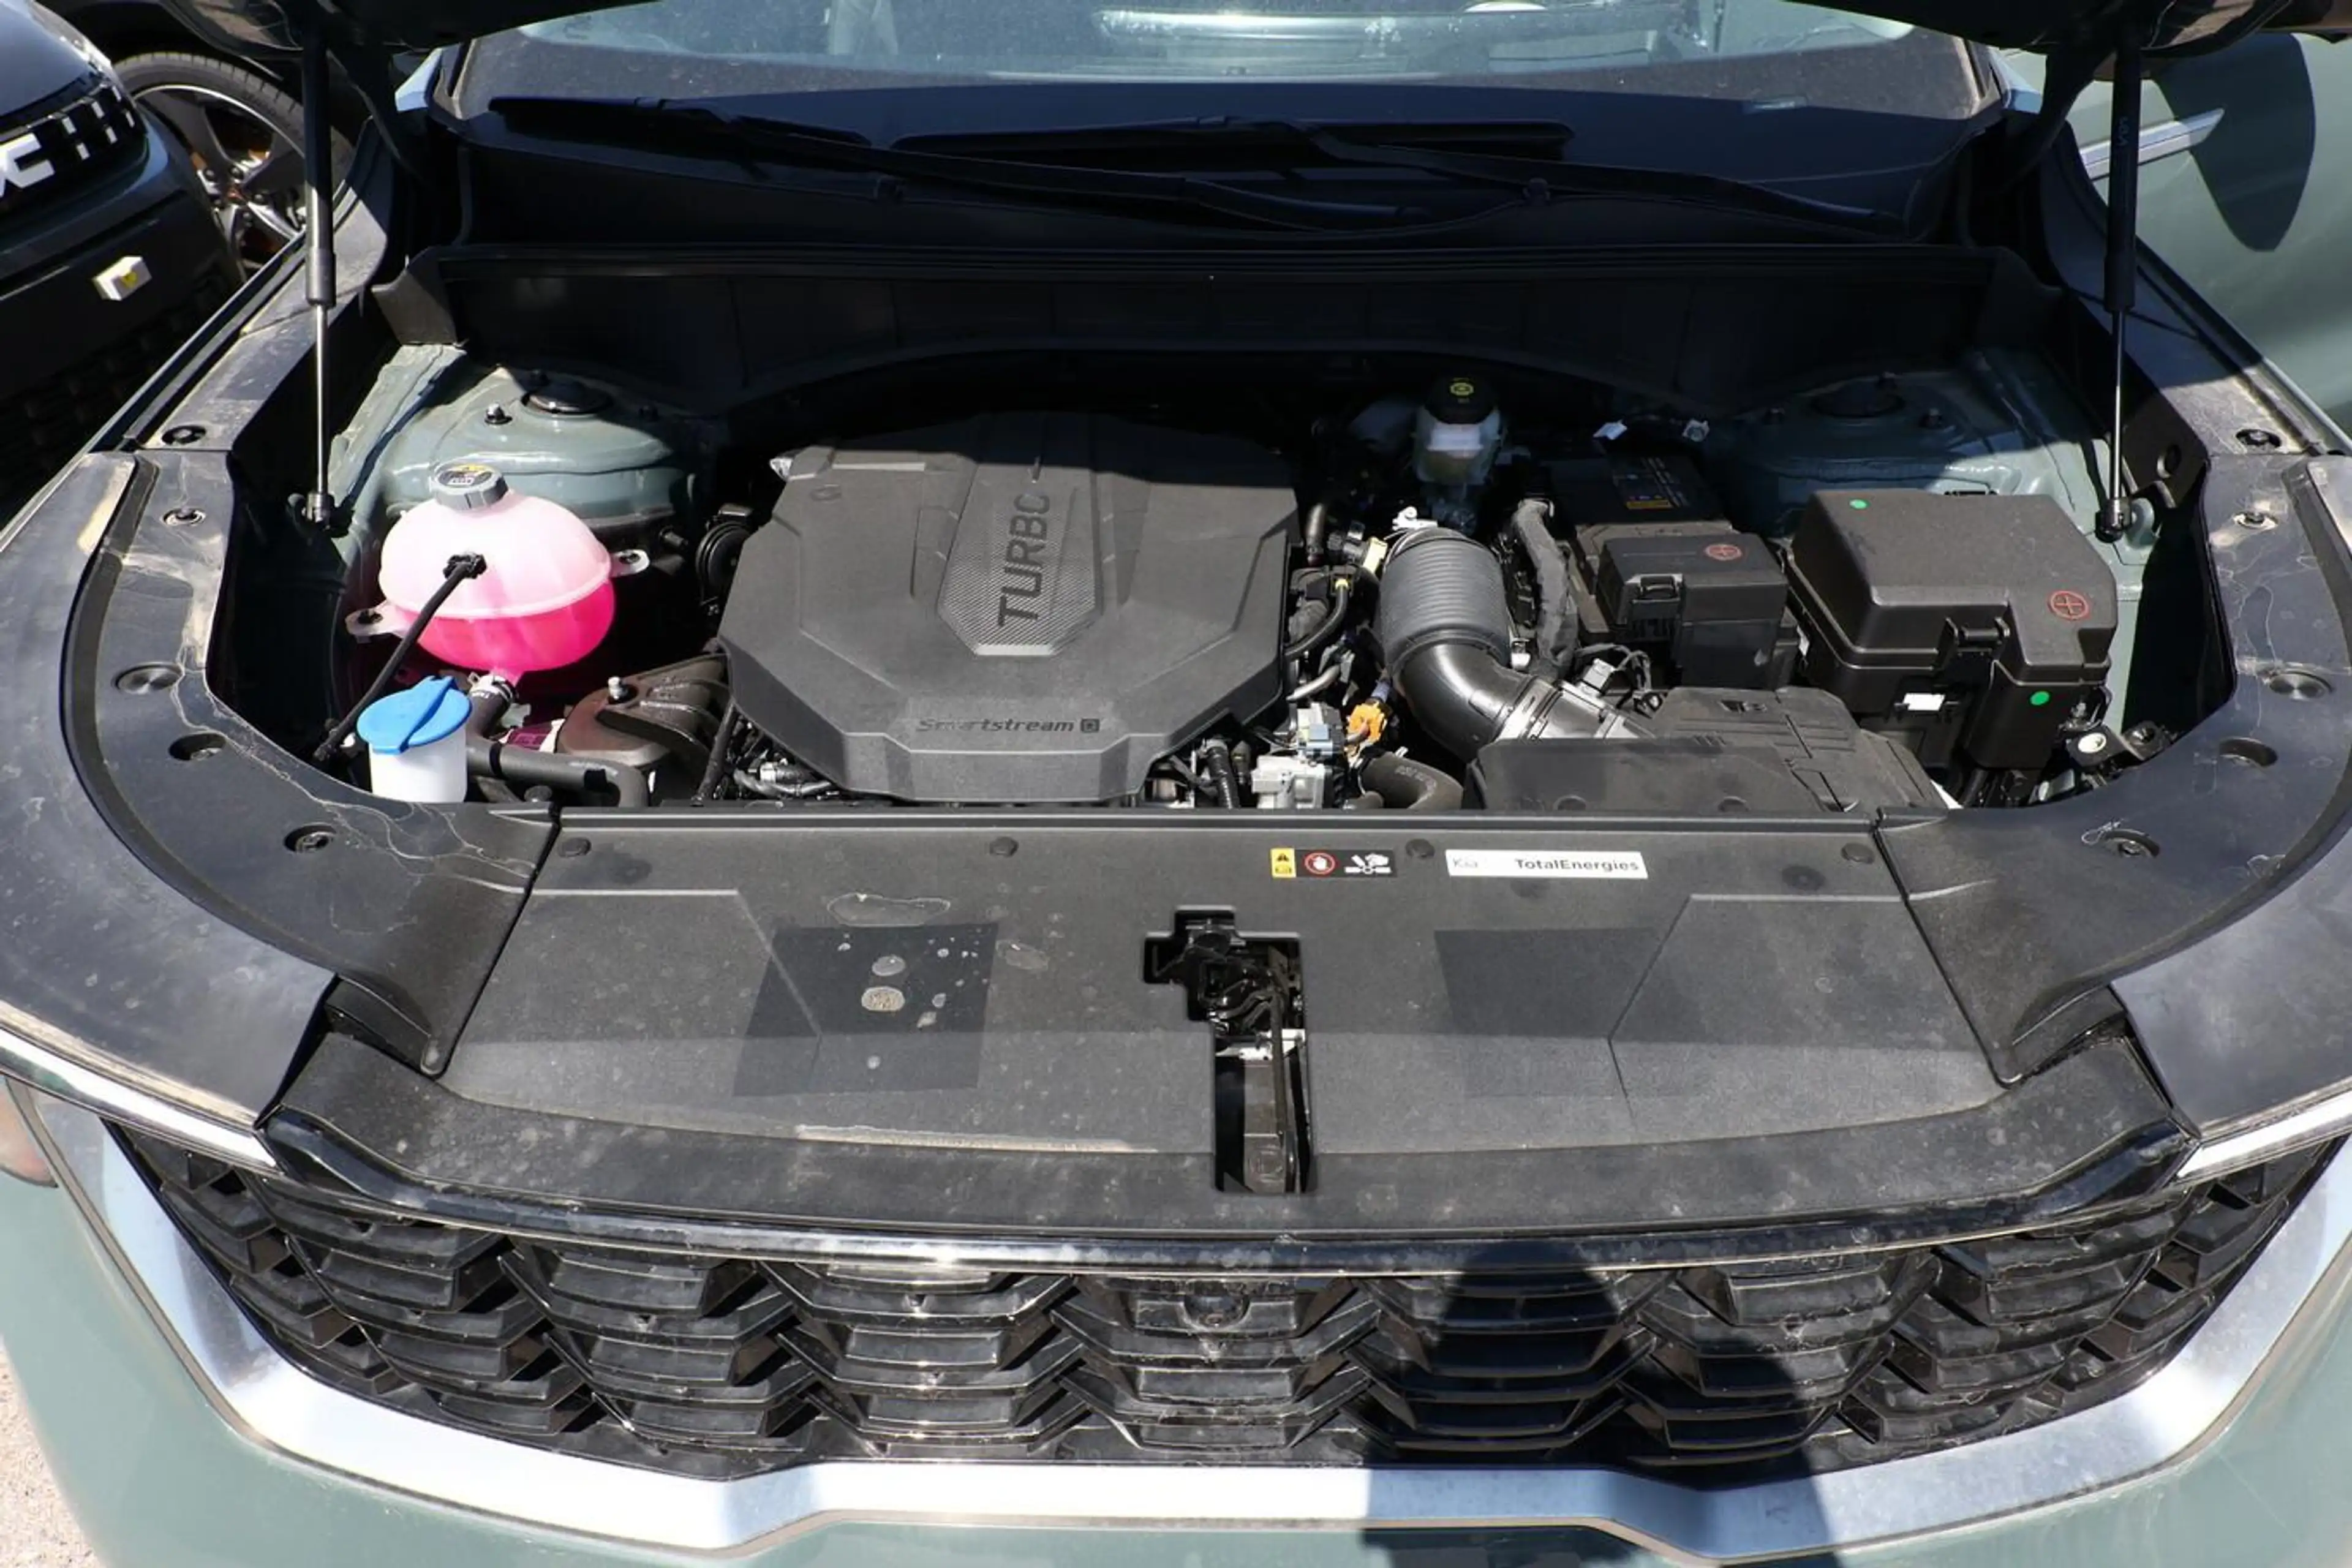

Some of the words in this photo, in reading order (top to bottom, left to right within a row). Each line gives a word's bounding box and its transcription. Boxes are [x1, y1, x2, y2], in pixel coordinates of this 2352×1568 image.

[998, 494, 1050, 627] TURBO
[916, 718, 1074, 732] Smartstream
[1515, 859, 1639, 872] TotalEnergies
